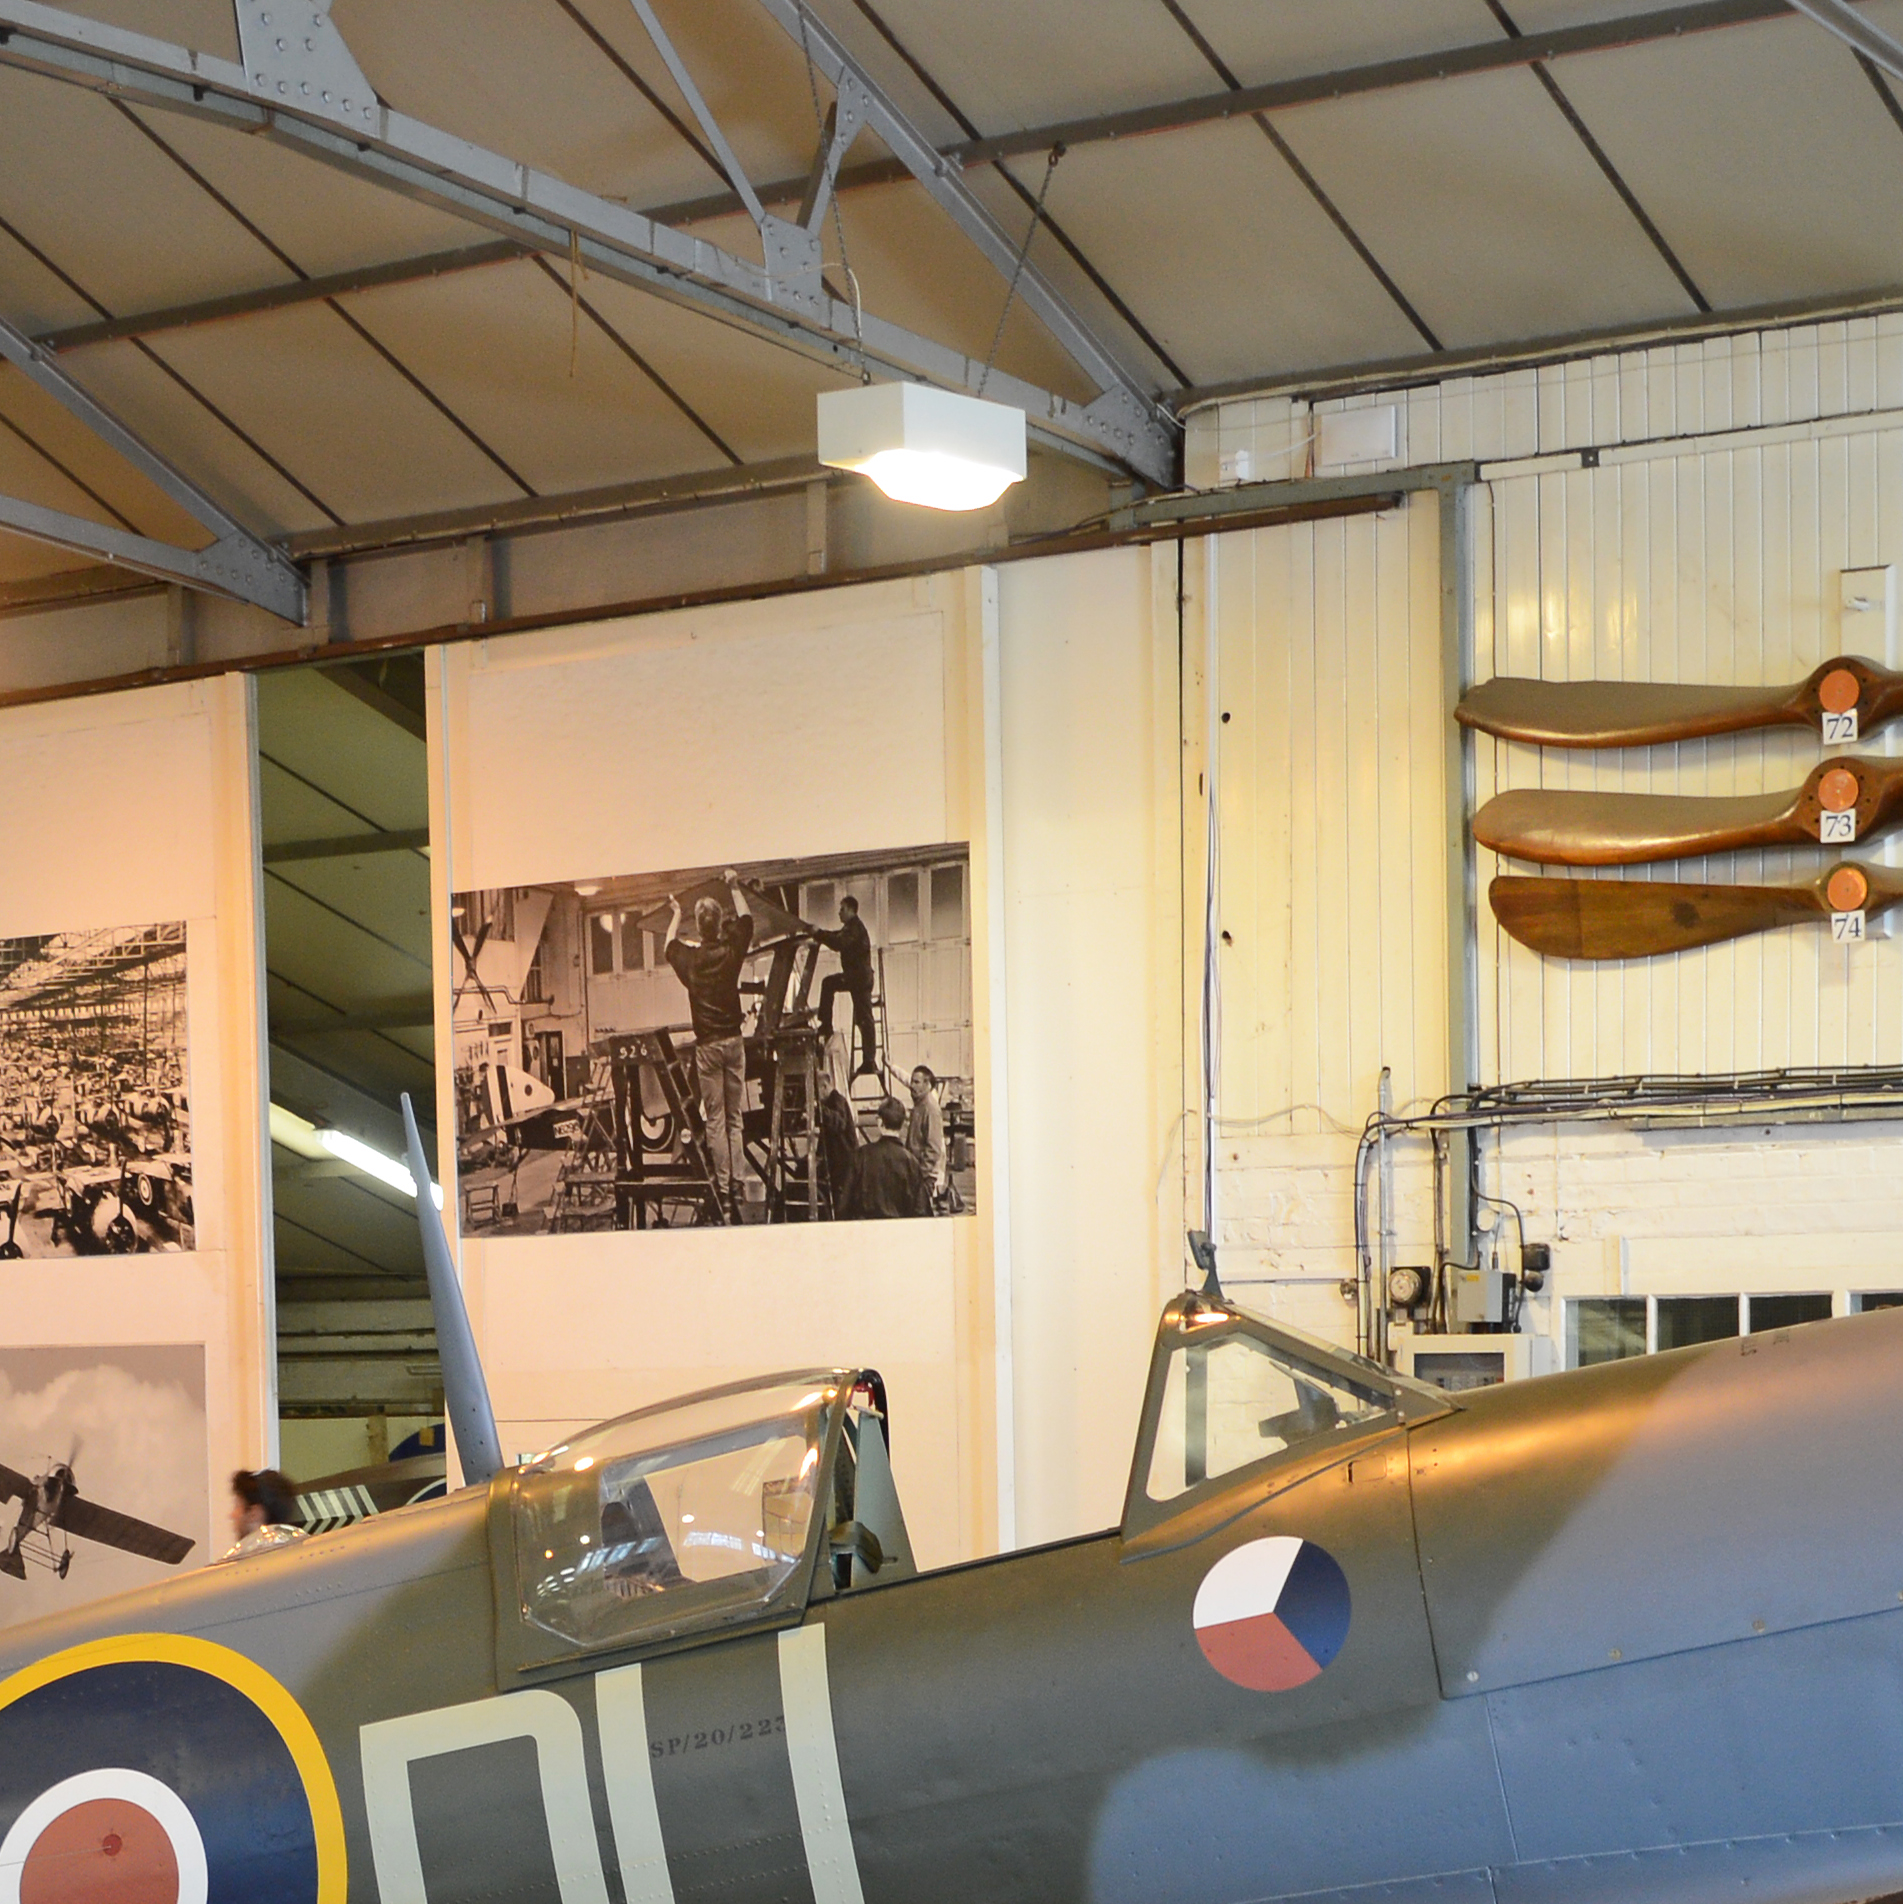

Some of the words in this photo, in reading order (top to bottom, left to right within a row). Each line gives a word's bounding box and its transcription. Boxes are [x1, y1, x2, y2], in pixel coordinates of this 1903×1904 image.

[1826, 717, 1854, 740] 72
[1825, 815, 1852, 837] 73
[1834, 917, 1862, 940] 74
